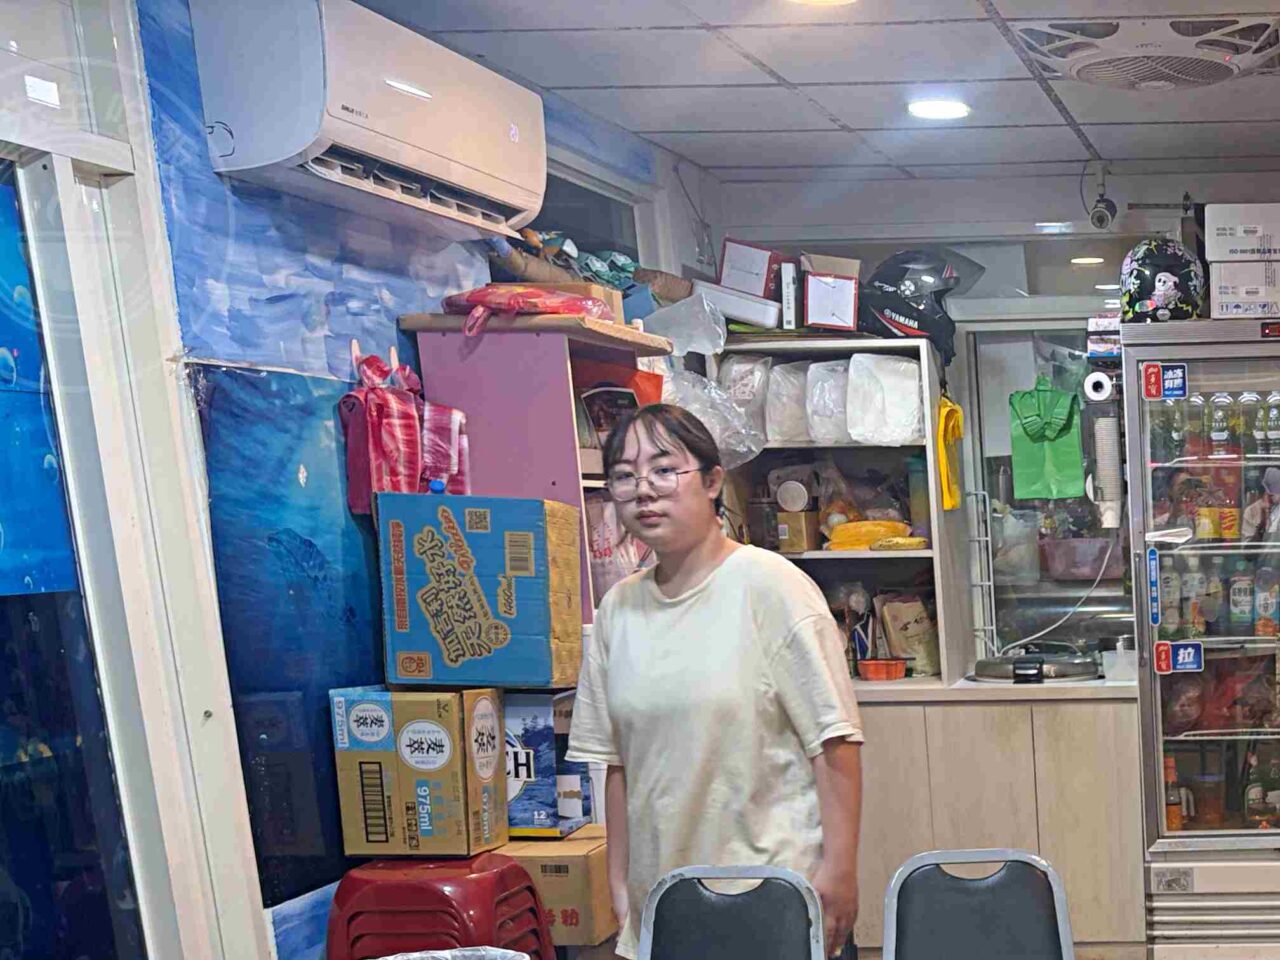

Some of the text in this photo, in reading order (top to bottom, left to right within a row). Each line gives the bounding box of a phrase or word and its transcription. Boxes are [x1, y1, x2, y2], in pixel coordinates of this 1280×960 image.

[891, 311, 919, 329] YAMAHA
[417, 530, 491, 657] 天然好水
[1177, 647, 1195, 664] 拉
[335, 700, 347, 745] 975ml
[416, 786, 432, 831] 975ml
[533, 811, 546, 819] 12
